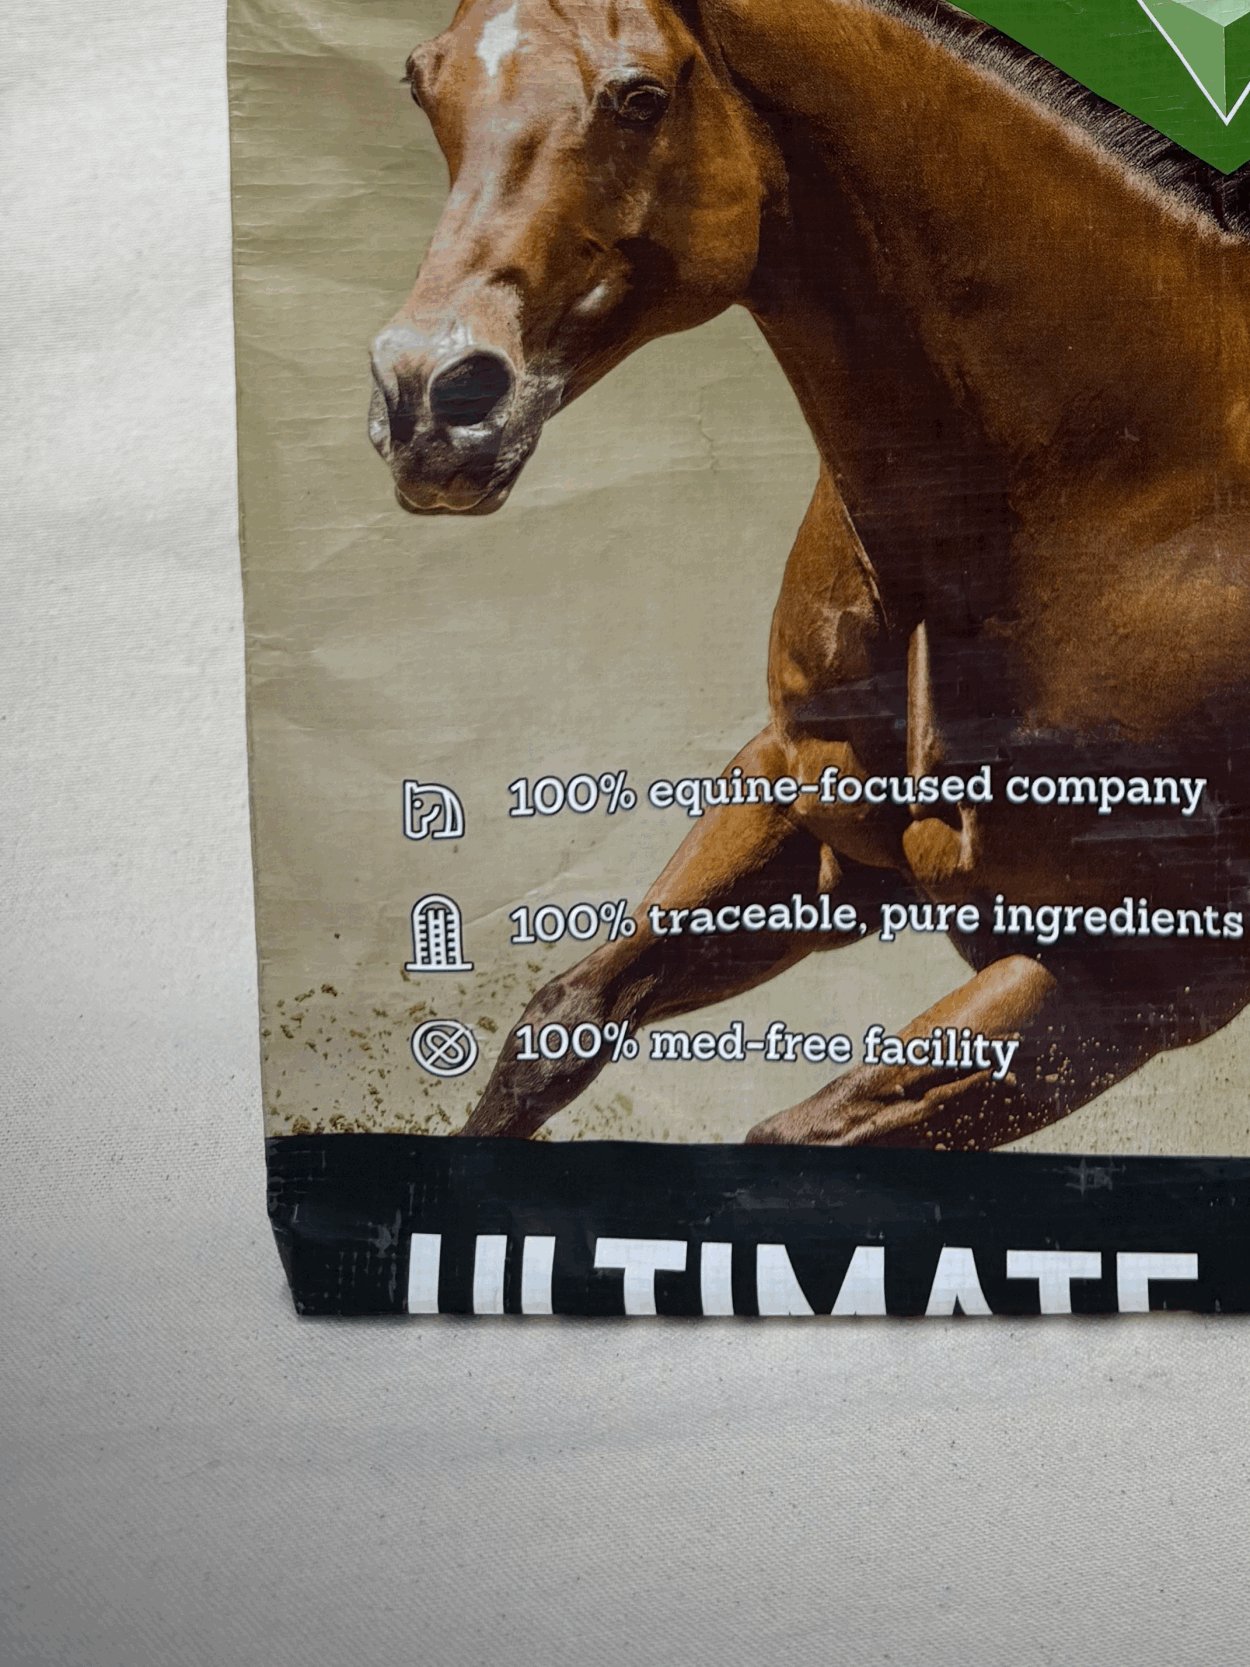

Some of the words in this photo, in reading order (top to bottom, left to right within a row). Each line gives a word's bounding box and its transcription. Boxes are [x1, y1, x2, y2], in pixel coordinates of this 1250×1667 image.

[508, 771, 637, 817] 100%
[647, 765, 994, 817] equine-focused
[1005, 772, 1208, 814] company
[508, 899, 637, 944] 100%
[648, 894, 869, 936] traceable,
[878, 900, 981, 940] pure
[992, 893, 1245, 944] ingredients
[513, 1021, 640, 1064] 100%
[649, 1021, 853, 1065] med-free
[862, 1024, 1020, 1078] facility
